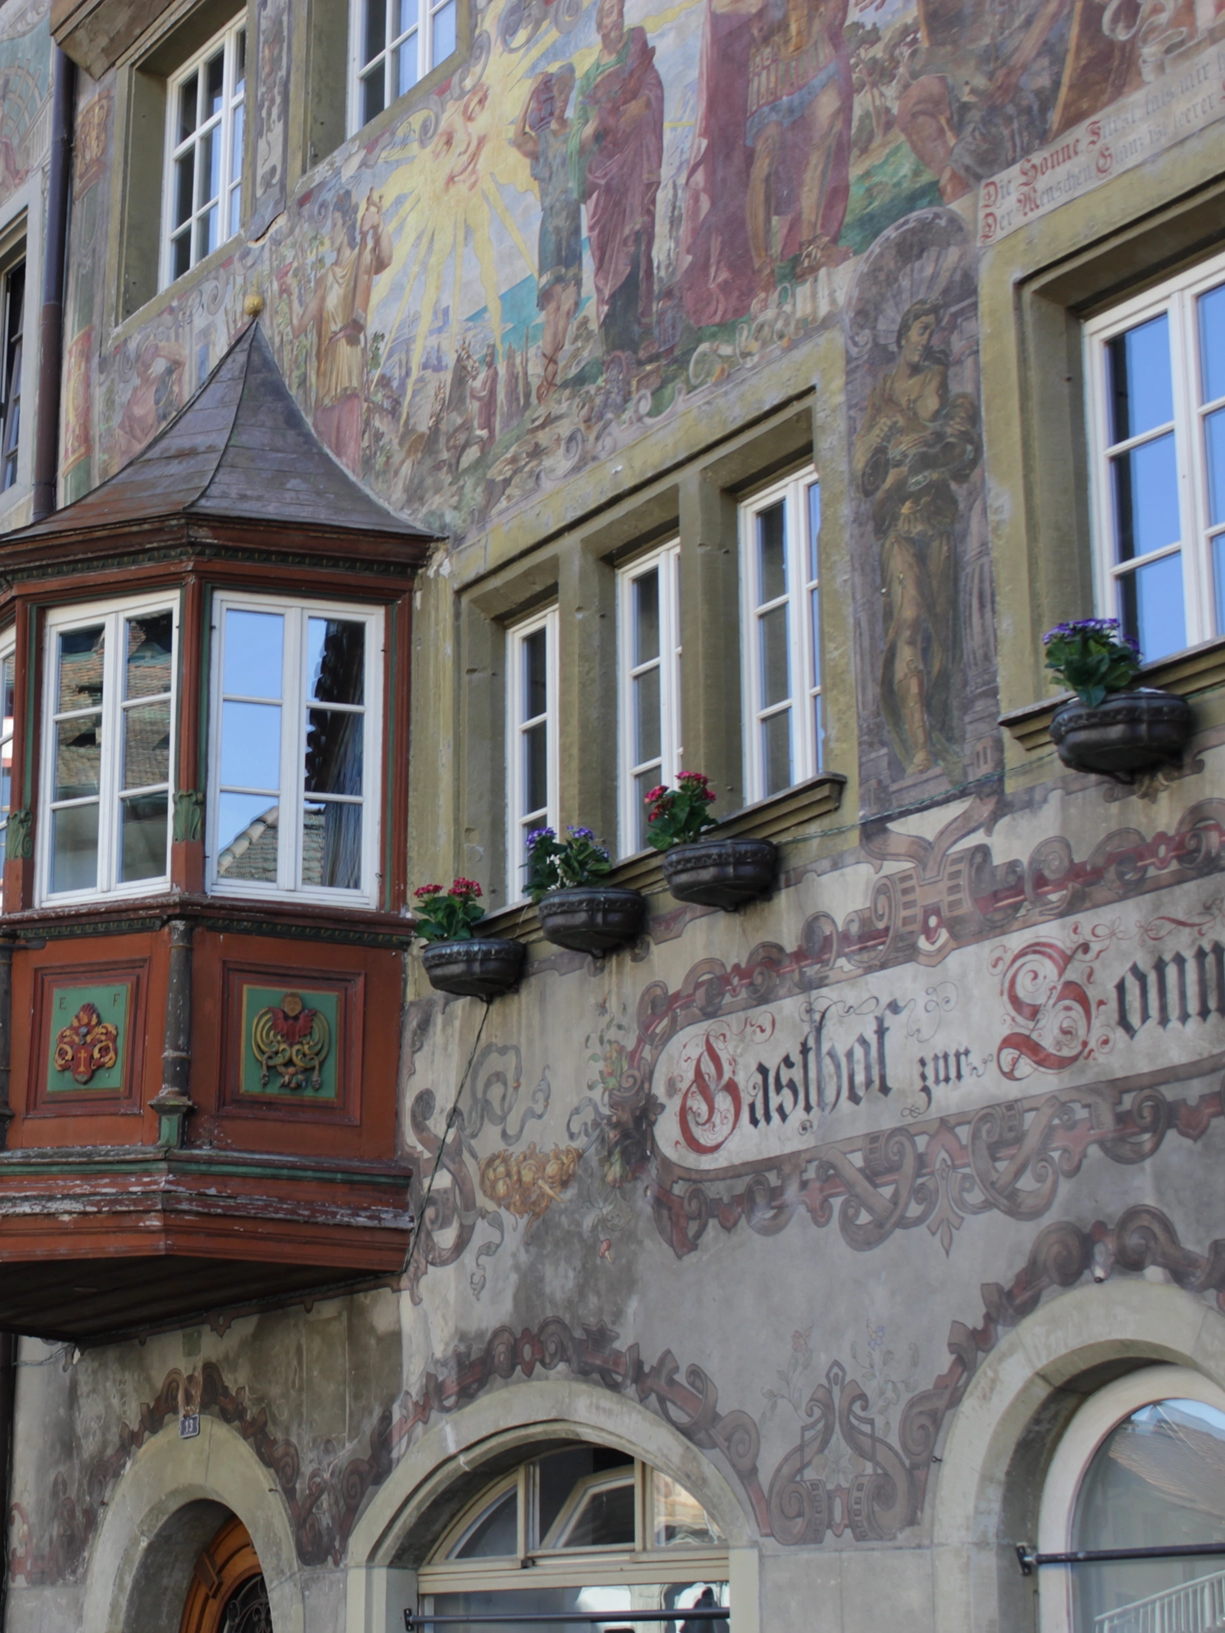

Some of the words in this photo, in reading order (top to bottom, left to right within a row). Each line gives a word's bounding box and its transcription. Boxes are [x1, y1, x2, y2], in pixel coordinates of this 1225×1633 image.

[979, 209, 1014, 245] Der
[1016, 164, 1094, 217] Menschen
[980, 178, 1013, 211] Die
[59, 997, 67, 1011] E
[113, 992, 122, 1008] F
[678, 993, 908, 1155] Gasthof
[914, 1046, 973, 1114] zur
